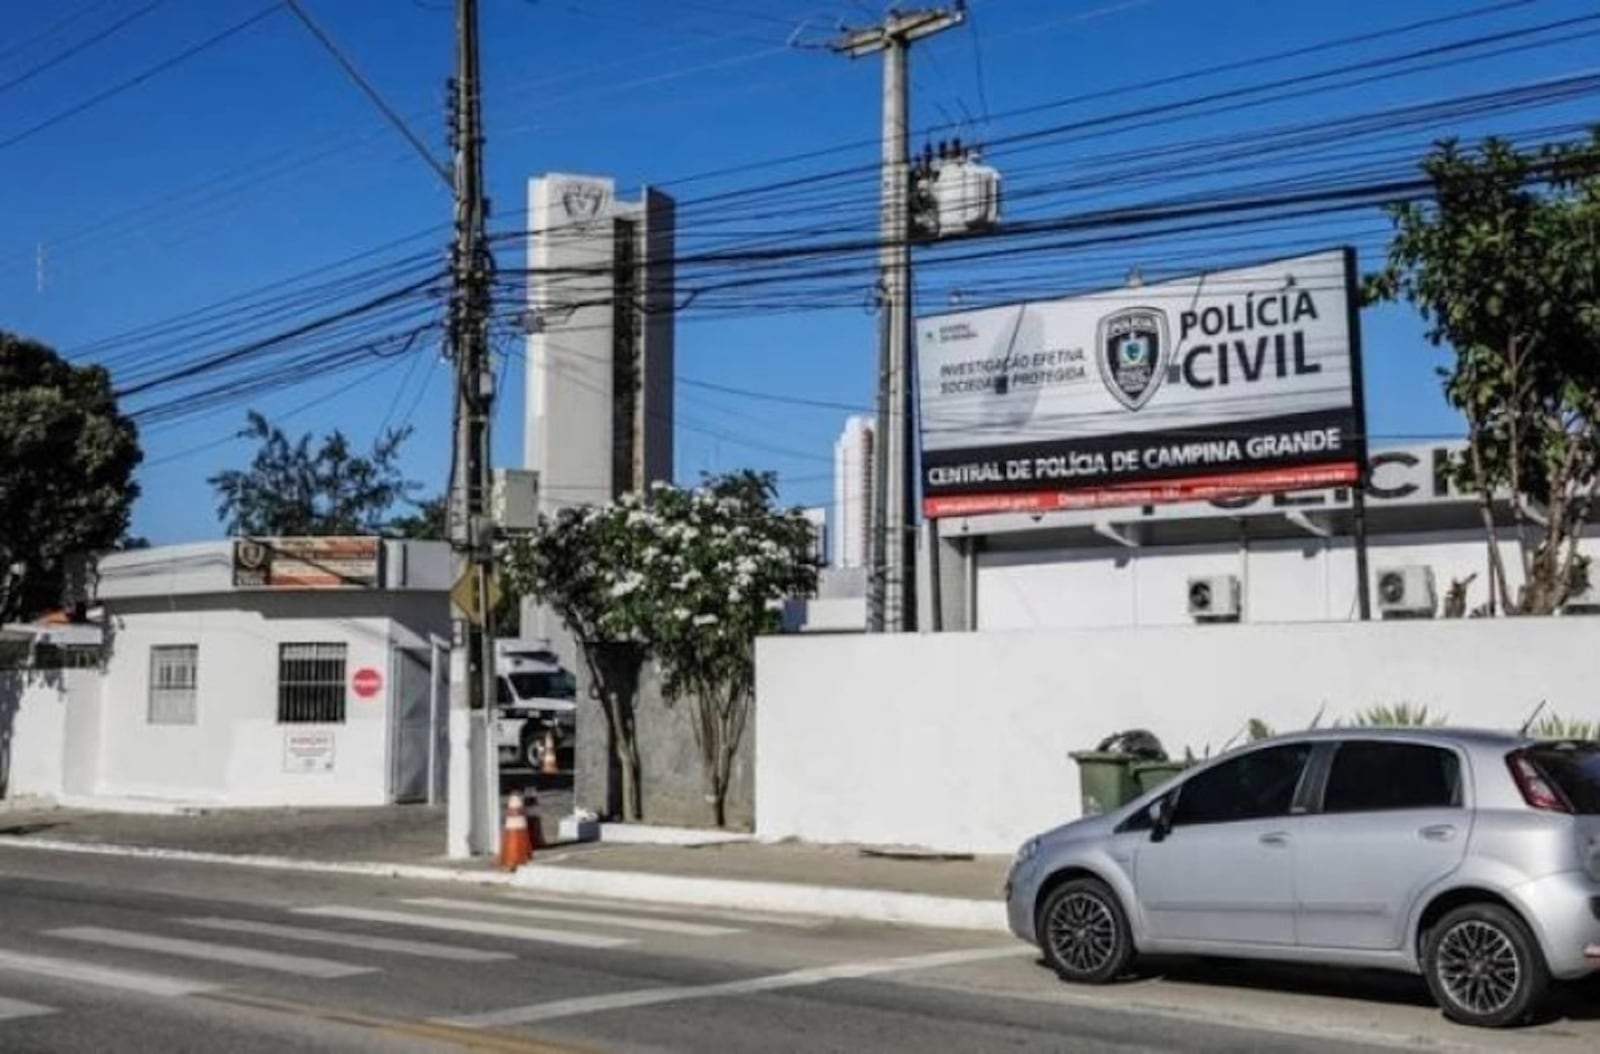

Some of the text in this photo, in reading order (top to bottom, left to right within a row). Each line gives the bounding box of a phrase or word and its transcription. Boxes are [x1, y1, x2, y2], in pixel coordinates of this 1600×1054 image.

[1180, 291, 1318, 340] POLÍCIA
[1182, 330, 1321, 389] CIVIL
[928, 428, 1341, 485] CENTRAL DE POLÍCIA DE CAMPINA GRANDE
